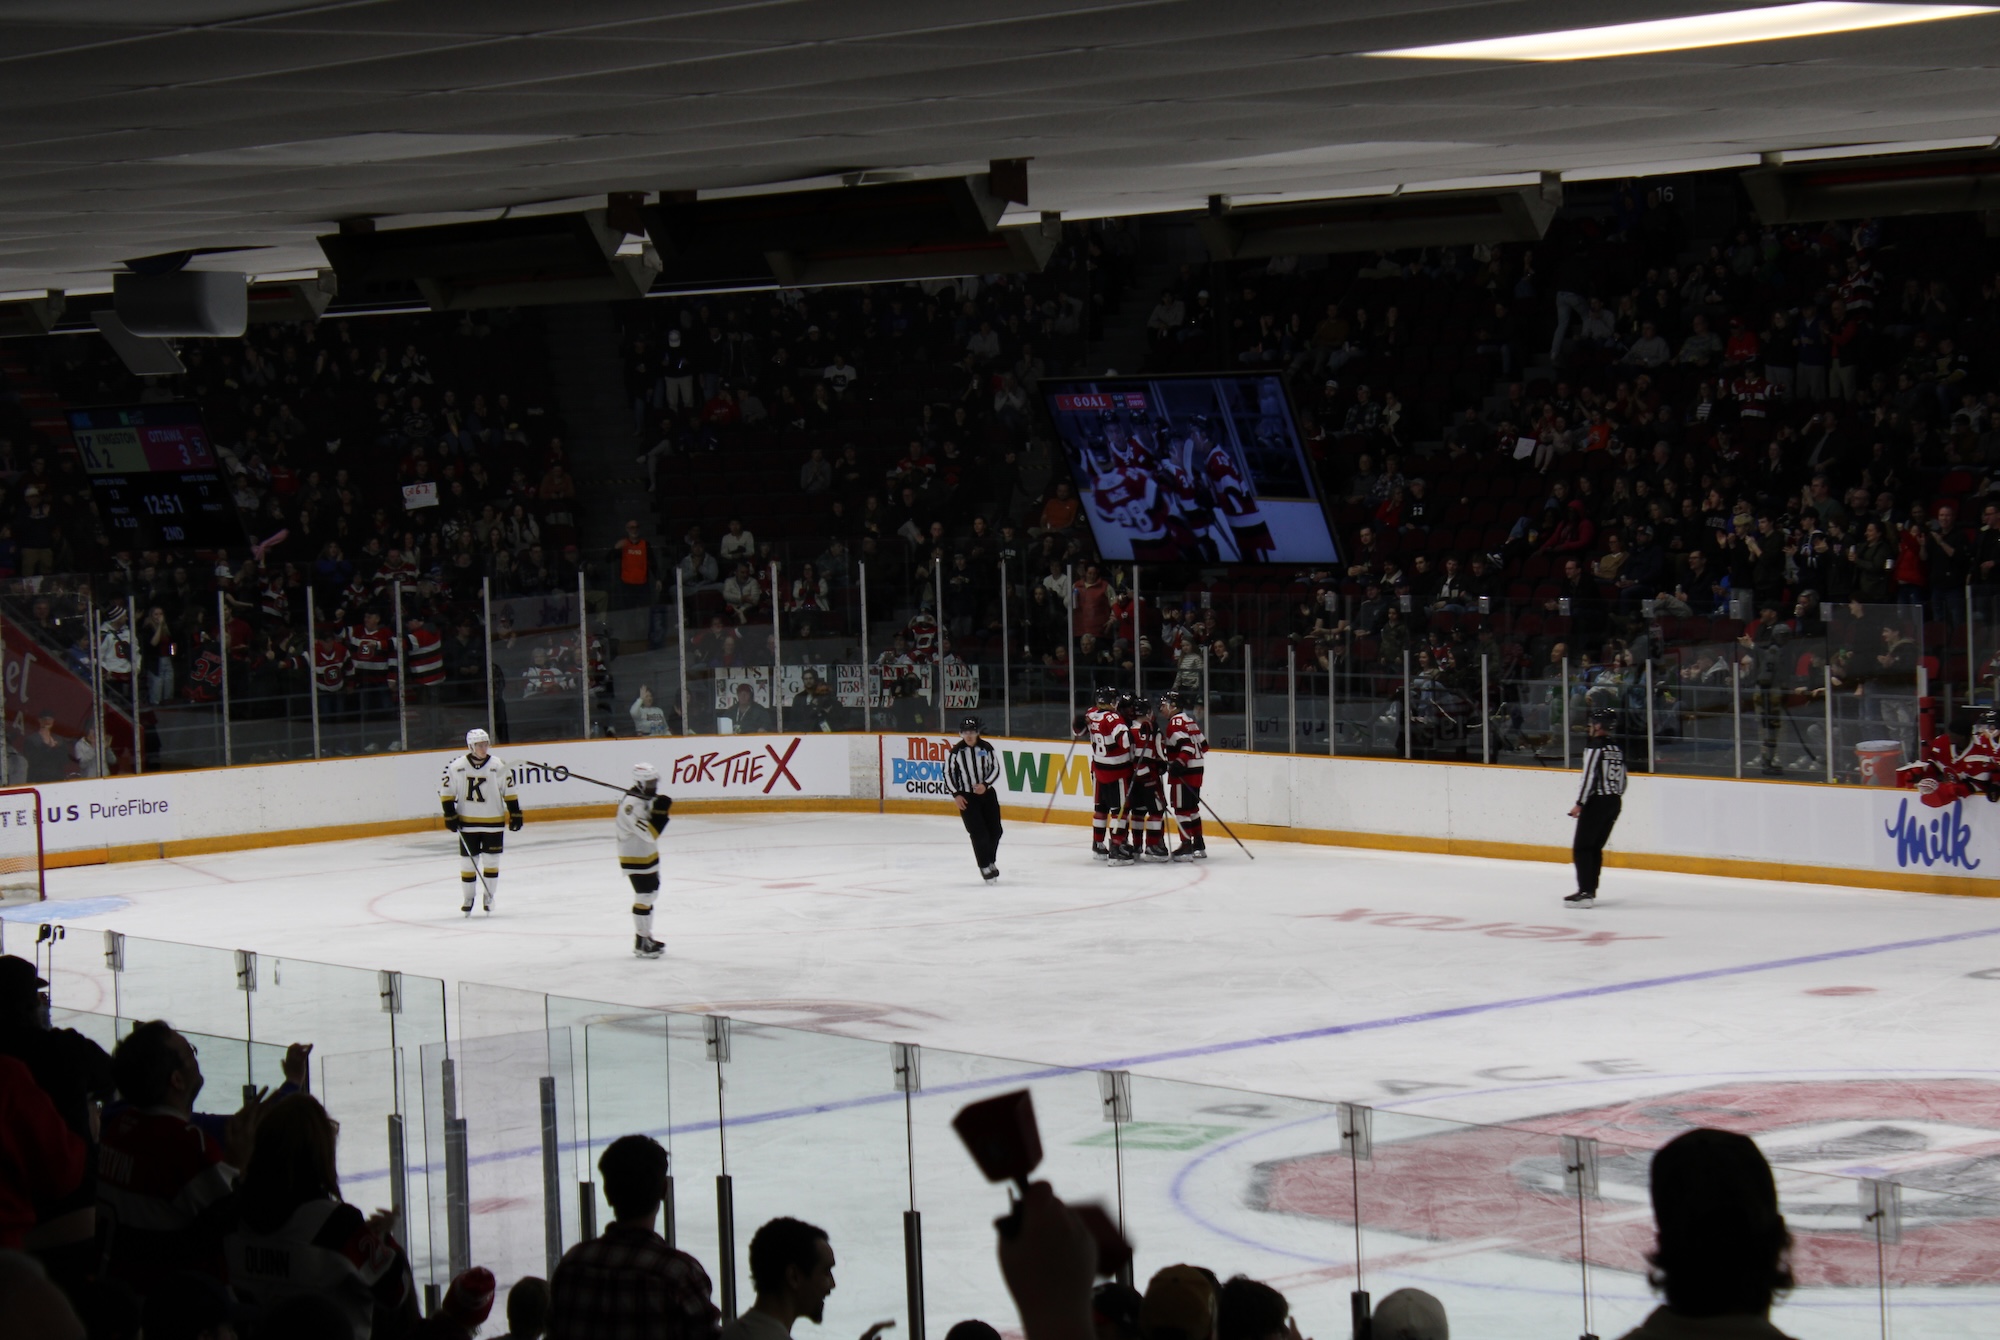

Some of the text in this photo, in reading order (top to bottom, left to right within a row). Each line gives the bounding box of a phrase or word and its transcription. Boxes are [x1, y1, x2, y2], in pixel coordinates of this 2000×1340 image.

[1656, 186, 1674, 203] 16
[1073, 395, 1107, 408] GOAL
[96, 431, 137, 446] KINGSTON
[147, 428, 185, 444] OTTAWA
[102, 447, 115, 469] 2
[178, 443, 192, 466] 3
[143, 494, 184, 515] 12:51
[162, 526, 185, 541] 2ND
[838, 665, 864, 678] RYDE
[1171, 718, 1183, 726] 19
[1002, 750, 1094, 797] WM
[1860, 758, 1875, 777] G
[466, 776, 487, 802] K
[906, 781, 951, 796] CHICKE
[89, 799, 169, 819] PureFibre
[244, 1246, 291, 1278] QUINN
